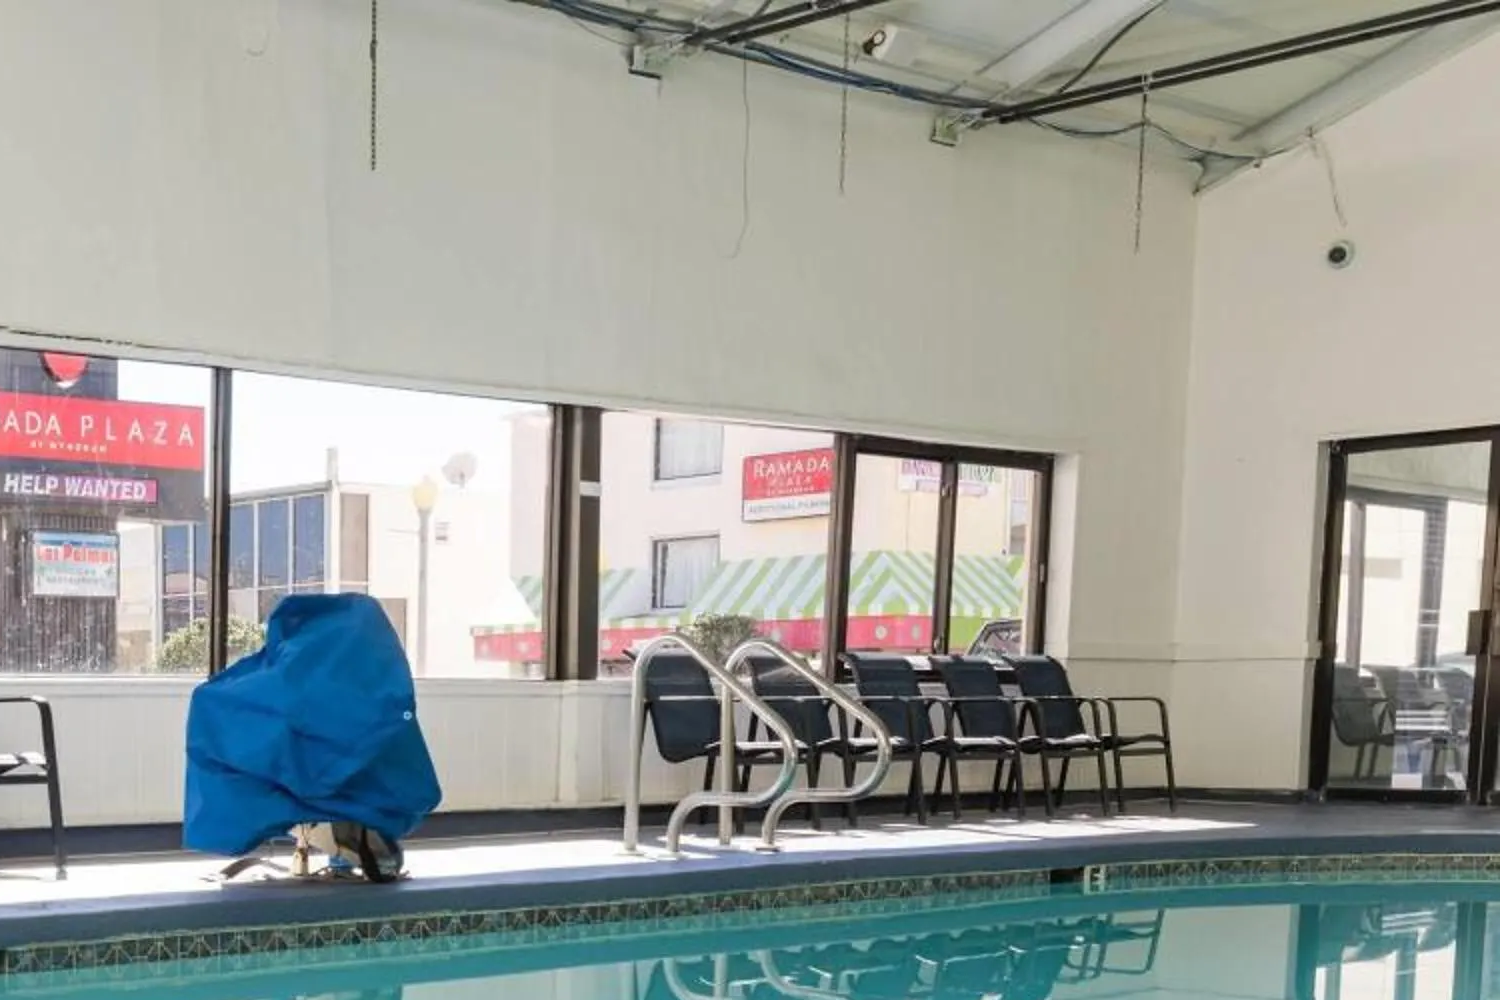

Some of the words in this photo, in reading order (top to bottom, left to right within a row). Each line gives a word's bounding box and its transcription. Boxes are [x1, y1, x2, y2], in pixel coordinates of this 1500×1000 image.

[80, 414, 194, 447] PLAZA
[753, 456, 830, 480] RAMADA
[3, 473, 59, 495] HELP
[64, 475, 148, 501] WANTED
